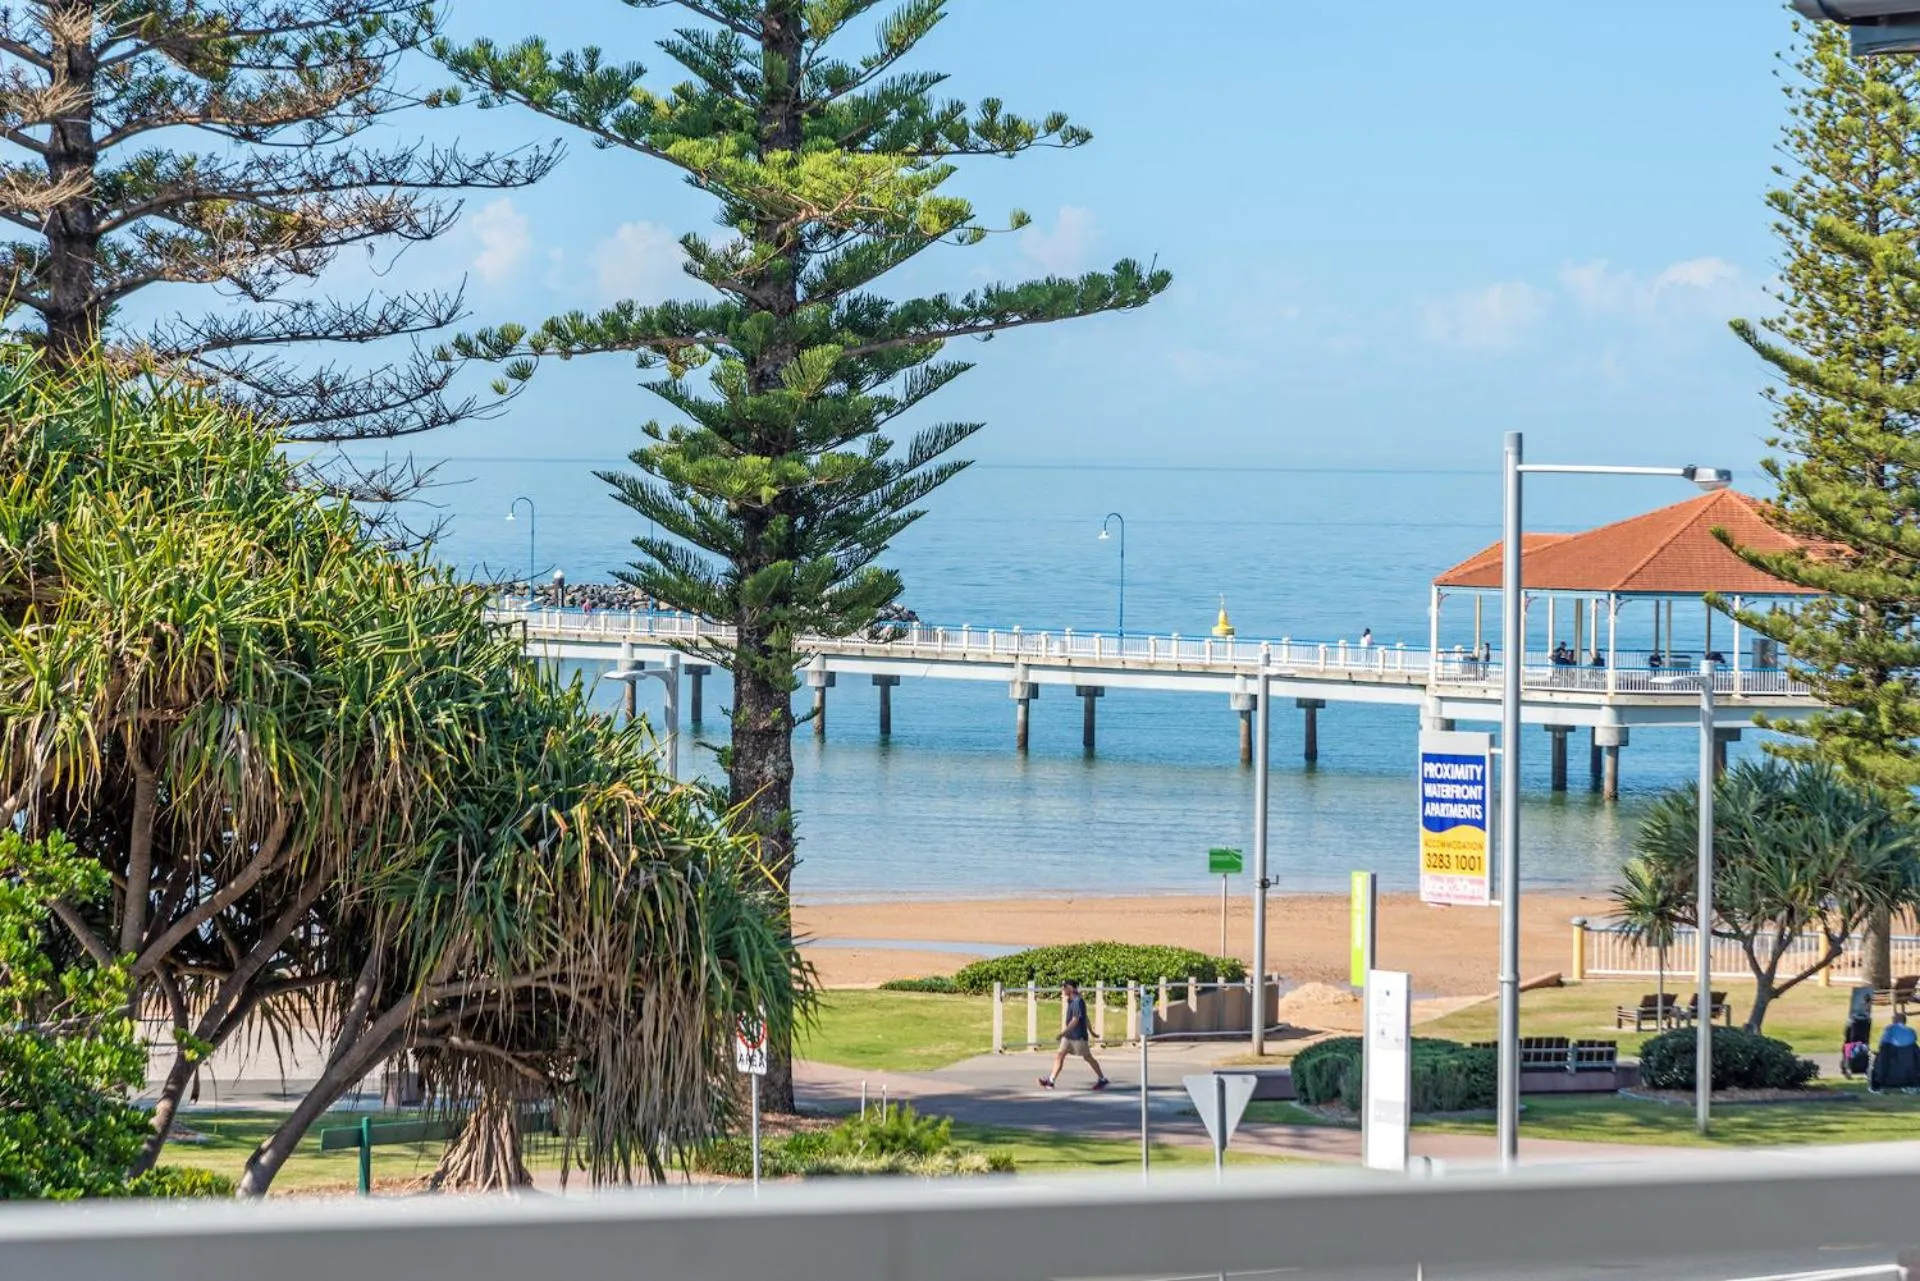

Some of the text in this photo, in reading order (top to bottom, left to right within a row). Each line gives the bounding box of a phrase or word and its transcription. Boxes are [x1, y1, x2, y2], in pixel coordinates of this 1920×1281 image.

[1424, 762, 1483, 780] PROXIMITY
[1424, 783, 1483, 800] WATERFRONT
[1424, 802, 1483, 819] APARTMENTS
[1425, 852, 1482, 871] 3283 1001
